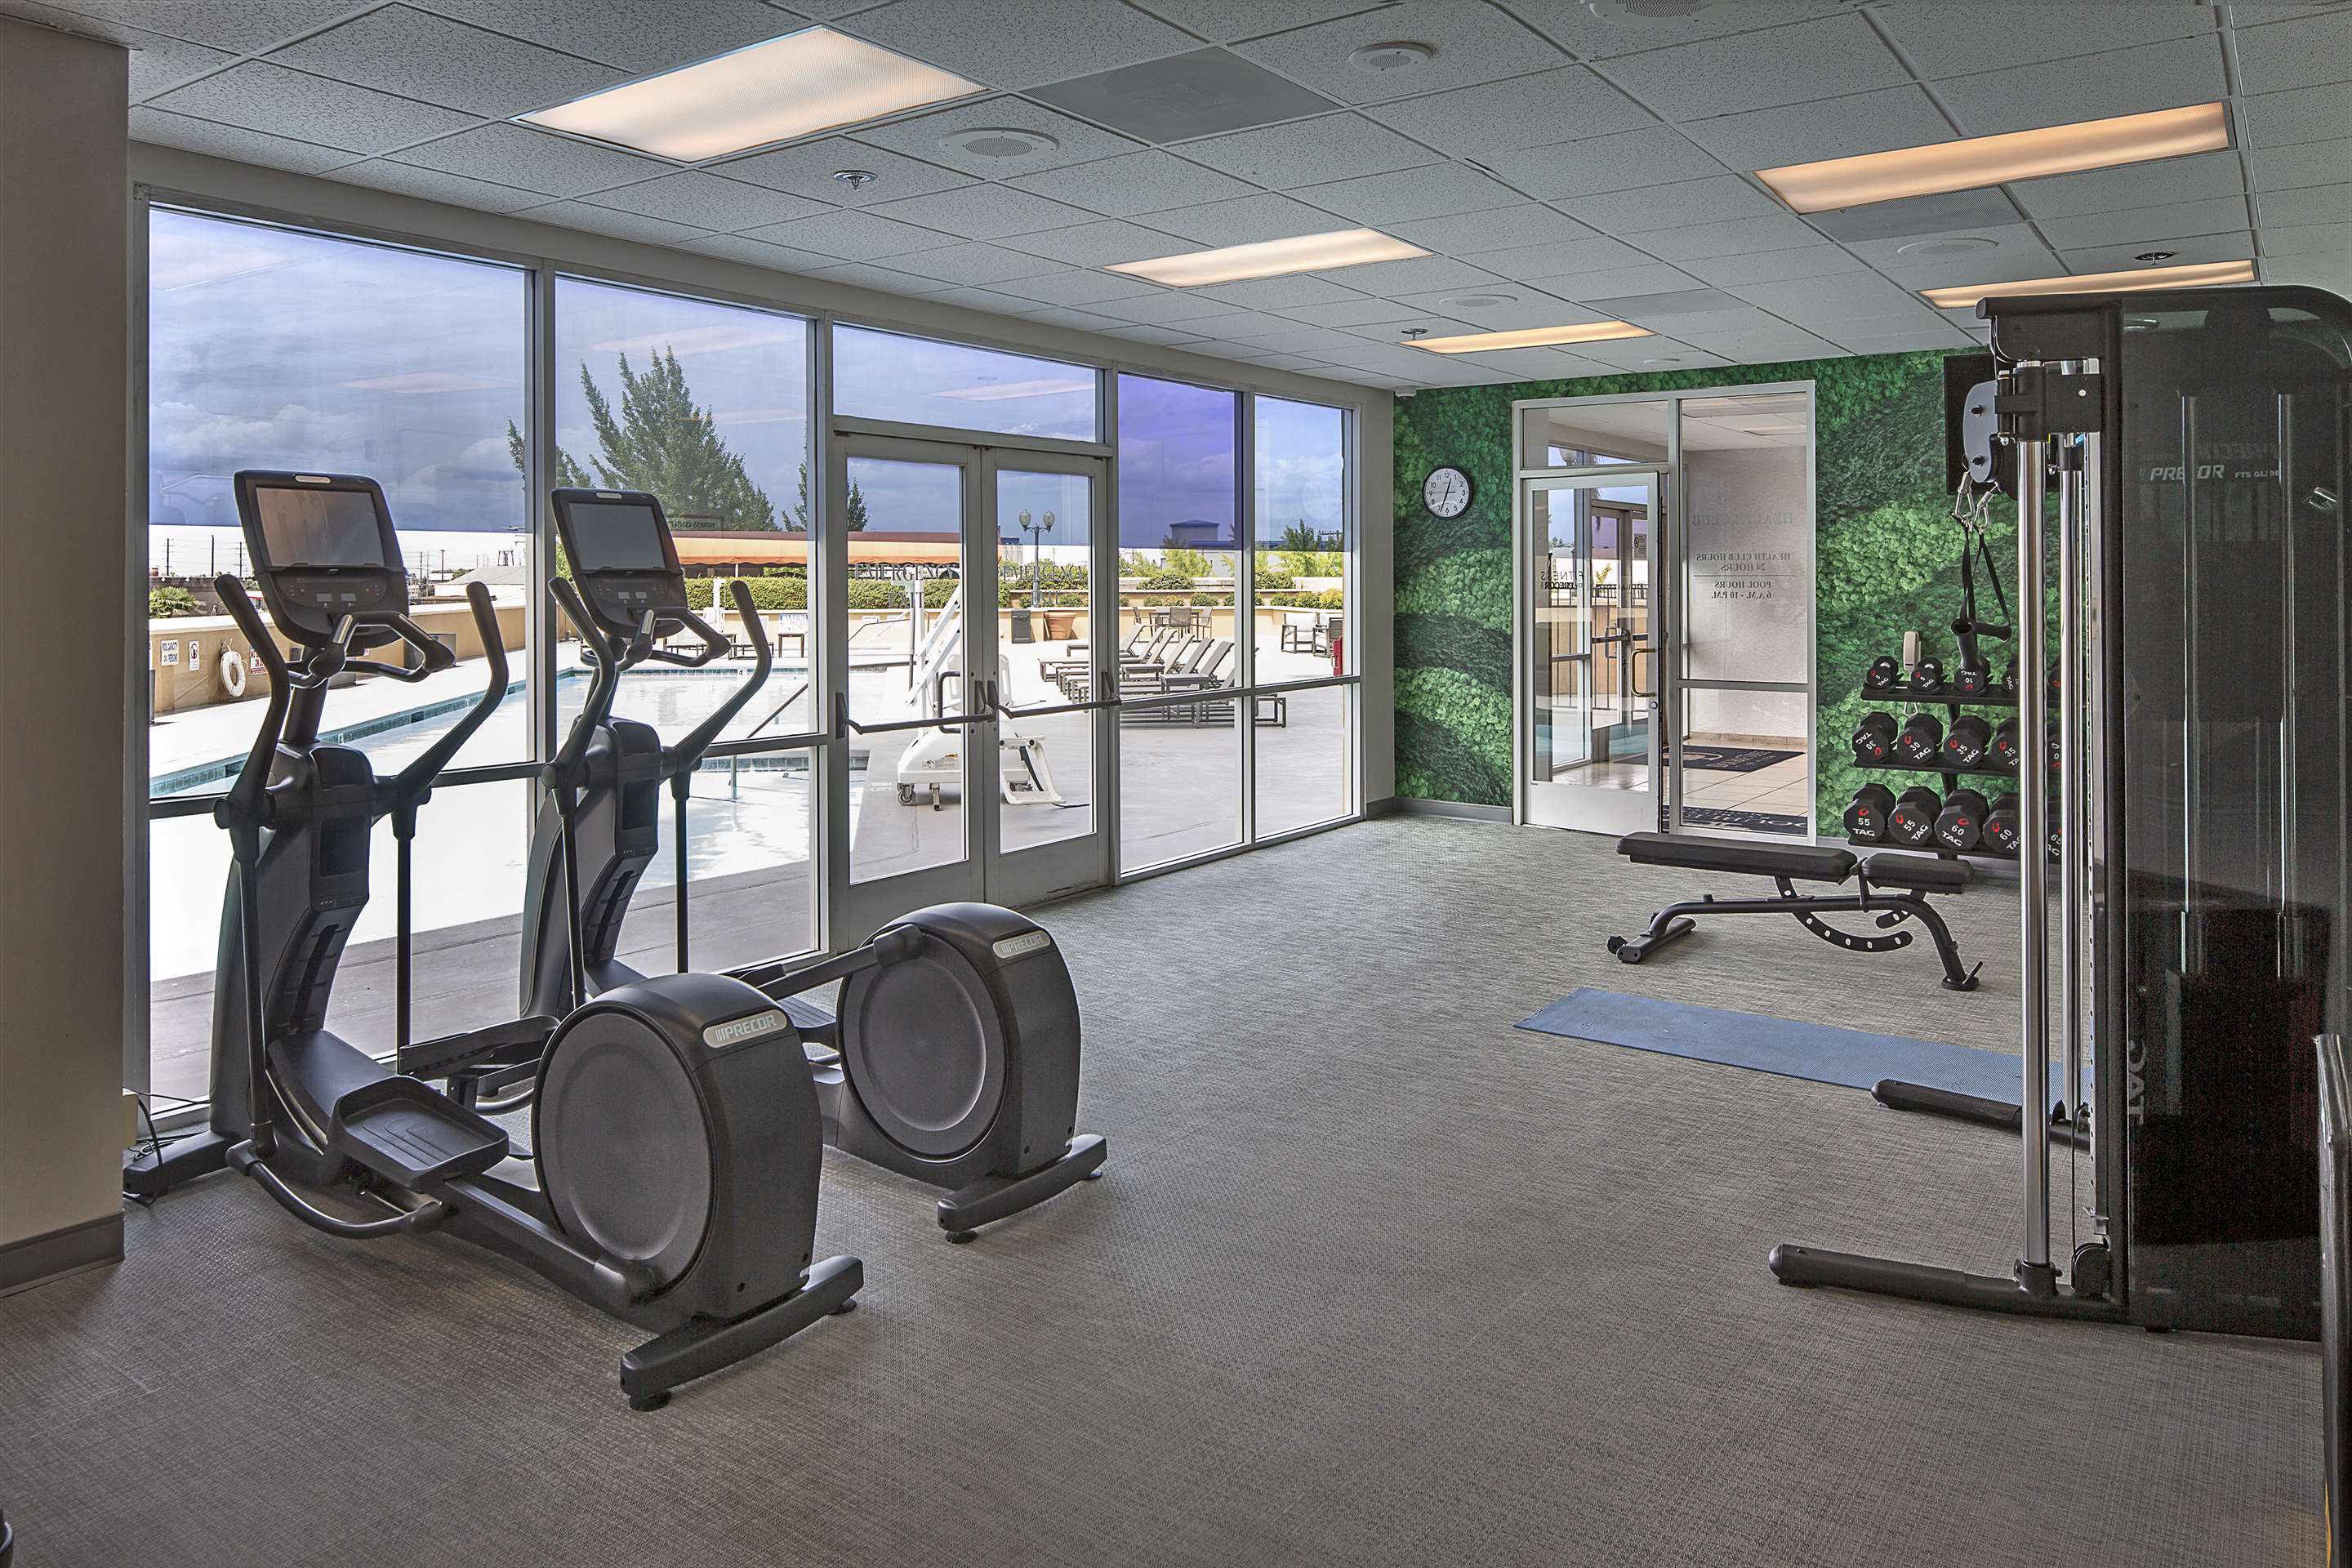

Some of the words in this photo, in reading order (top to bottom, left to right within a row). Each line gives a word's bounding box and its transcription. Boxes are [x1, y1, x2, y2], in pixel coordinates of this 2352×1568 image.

[2149, 465, 2225, 481] PREOR
[854, 564, 956, 581] EMERGENCY
[1031, 590, 1061, 605] XIT
[1878, 677, 1889, 687] TAG
[1922, 678, 1934, 688] TAG
[2006, 675, 2014, 690] TAG
[1855, 732, 1873, 745] TAG
[1865, 740, 1877, 751] 30
[1910, 742, 1921, 751] 30
[1957, 744, 1968, 755] 35
[1913, 746, 1931, 760] TAG
[1962, 749, 1980, 764] TAG
[2004, 747, 2016, 757] 35
[2008, 758, 2020, 767] TA
[1858, 817, 1870, 826] 55
[1904, 820, 1917, 832] 55
[1852, 828, 1876, 837] TAG
[1911, 825, 1929, 841] TAG
[1951, 824, 1965, 836] 60
[1999, 829, 2012, 840] 60
[1942, 831, 1964, 847] TAG
[2047, 844, 2060, 857] AG
[1004, 933, 1045, 952] PRECOR
[721, 1014, 777, 1040] PRECOR
